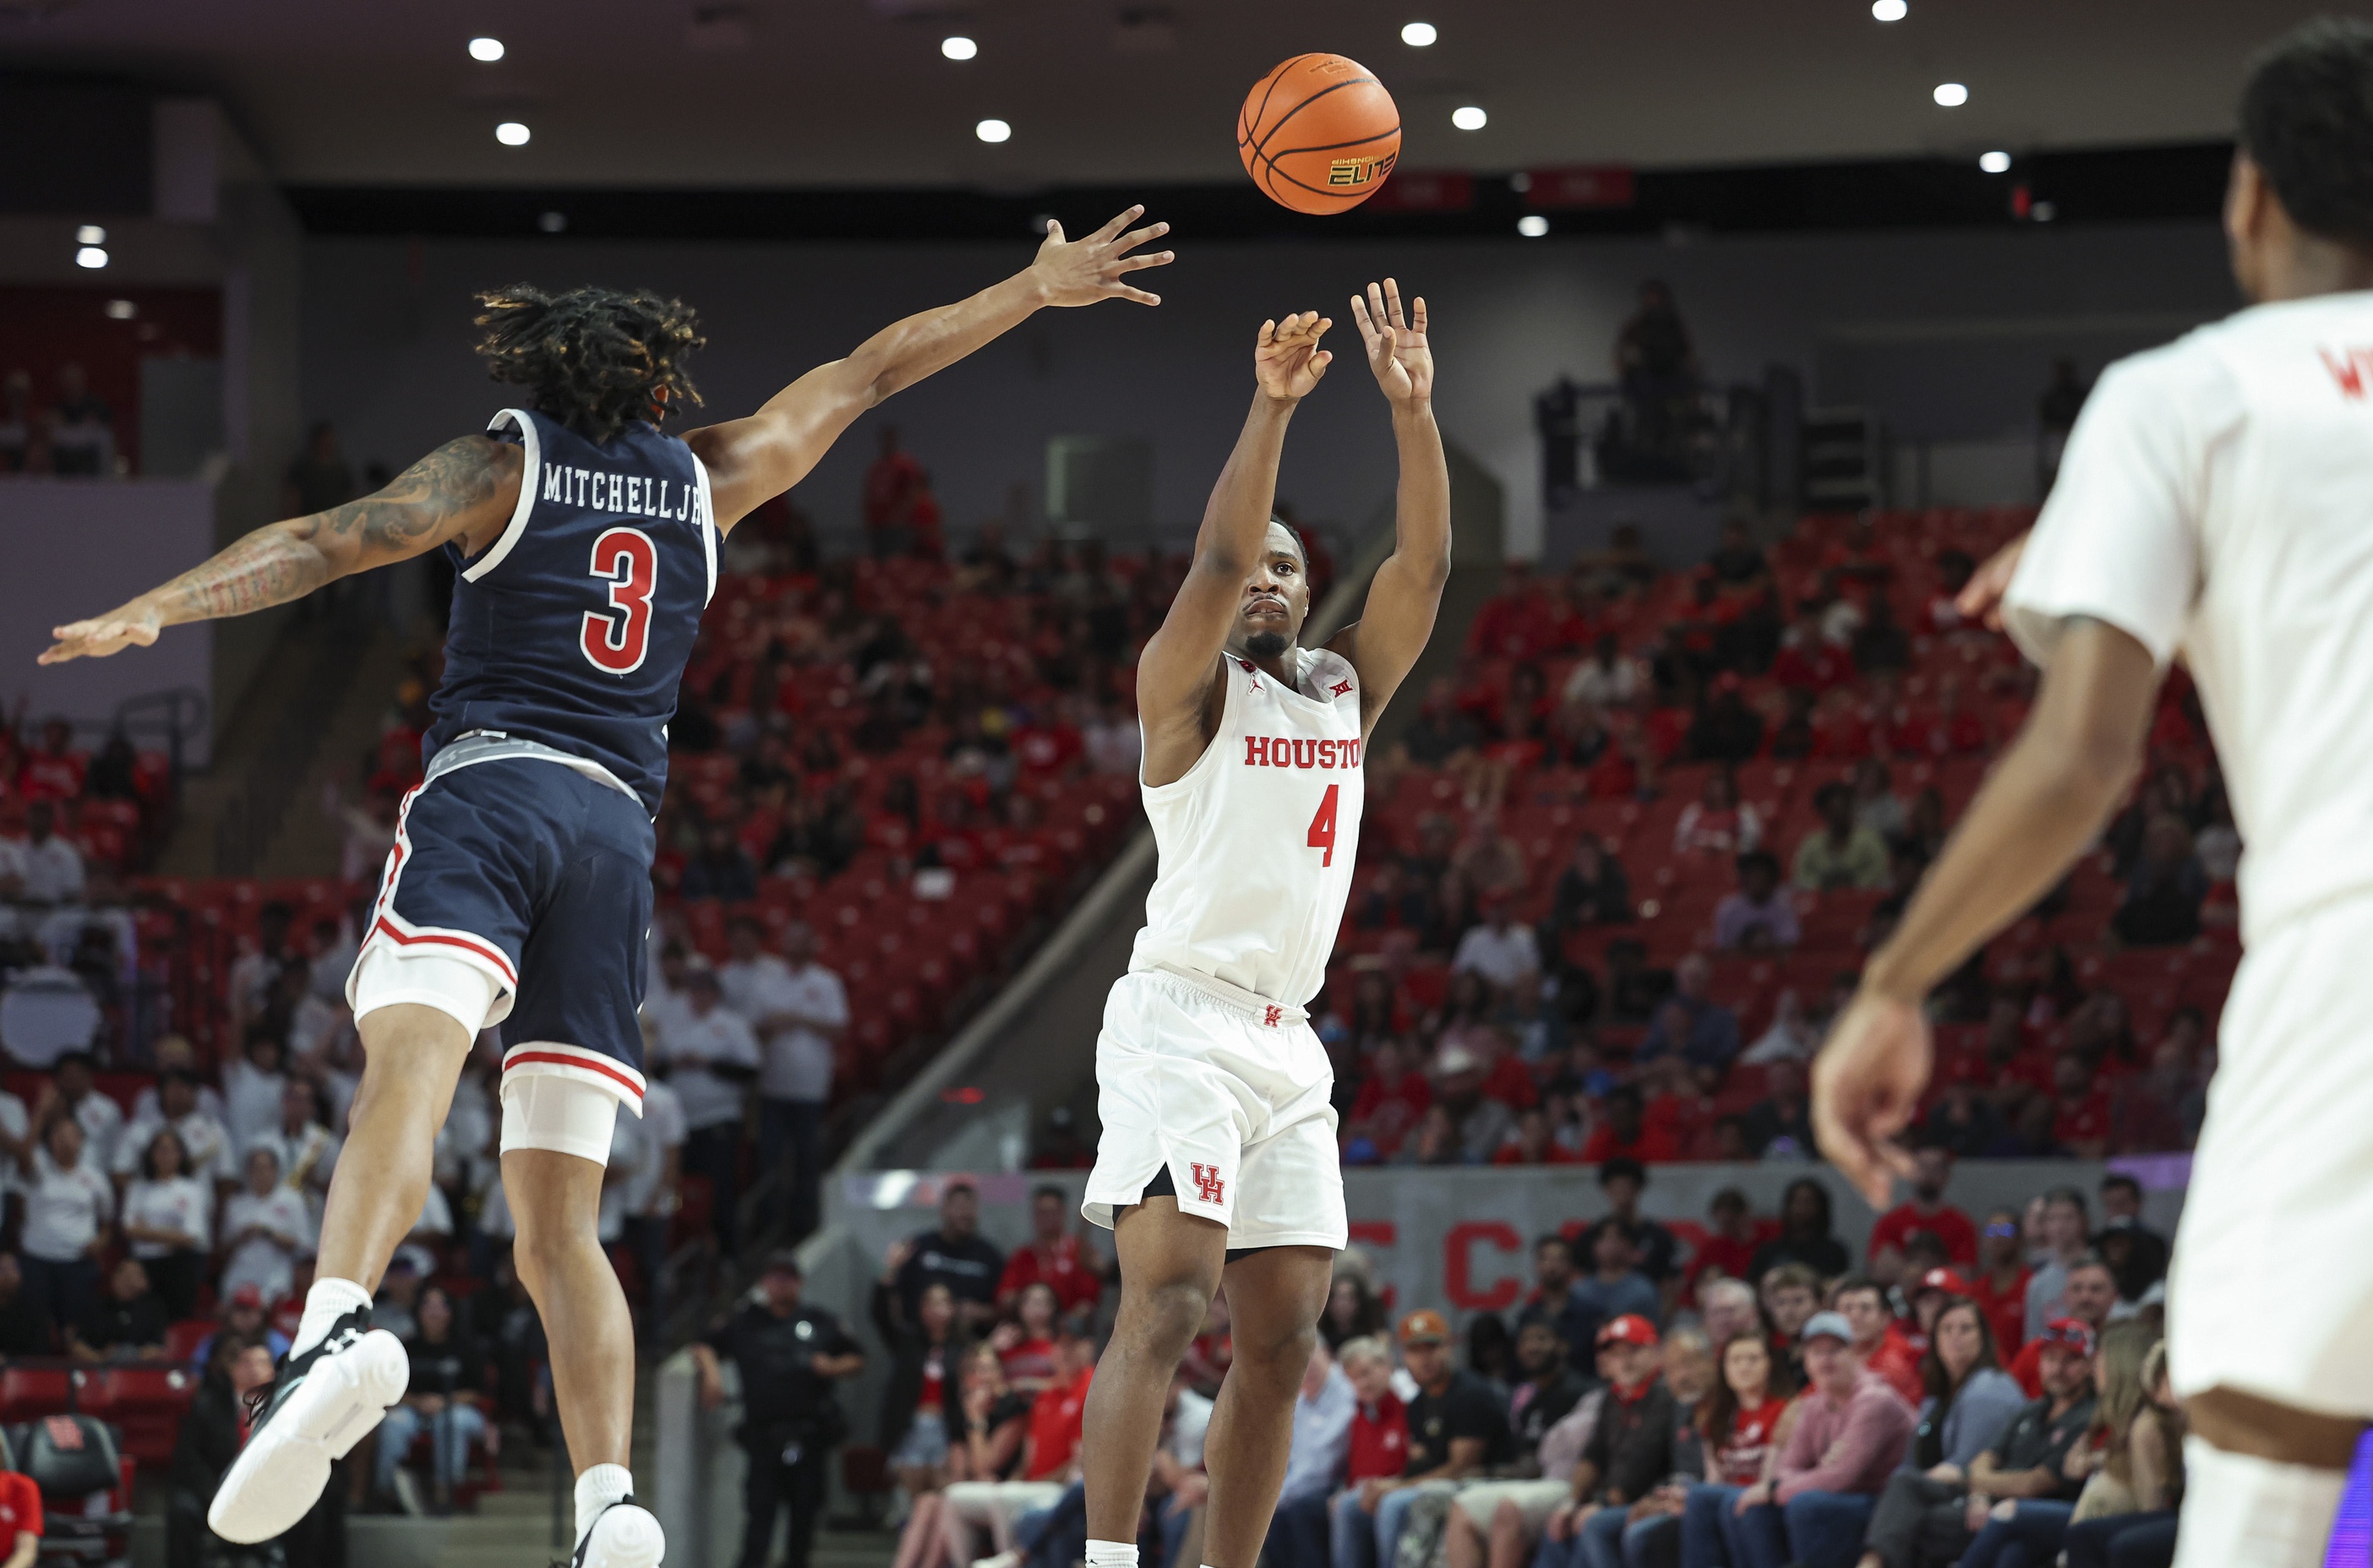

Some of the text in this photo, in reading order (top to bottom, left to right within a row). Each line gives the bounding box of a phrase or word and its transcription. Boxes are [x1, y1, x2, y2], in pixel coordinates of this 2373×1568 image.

[1328, 150, 1397, 186] ELITE
[543, 462, 672, 518] MITCHELL
[580, 526, 657, 675] 3
[1245, 736, 1361, 770] HOUSTO
[1307, 784, 1339, 868] 4
[1191, 1162, 1225, 1206] UH
